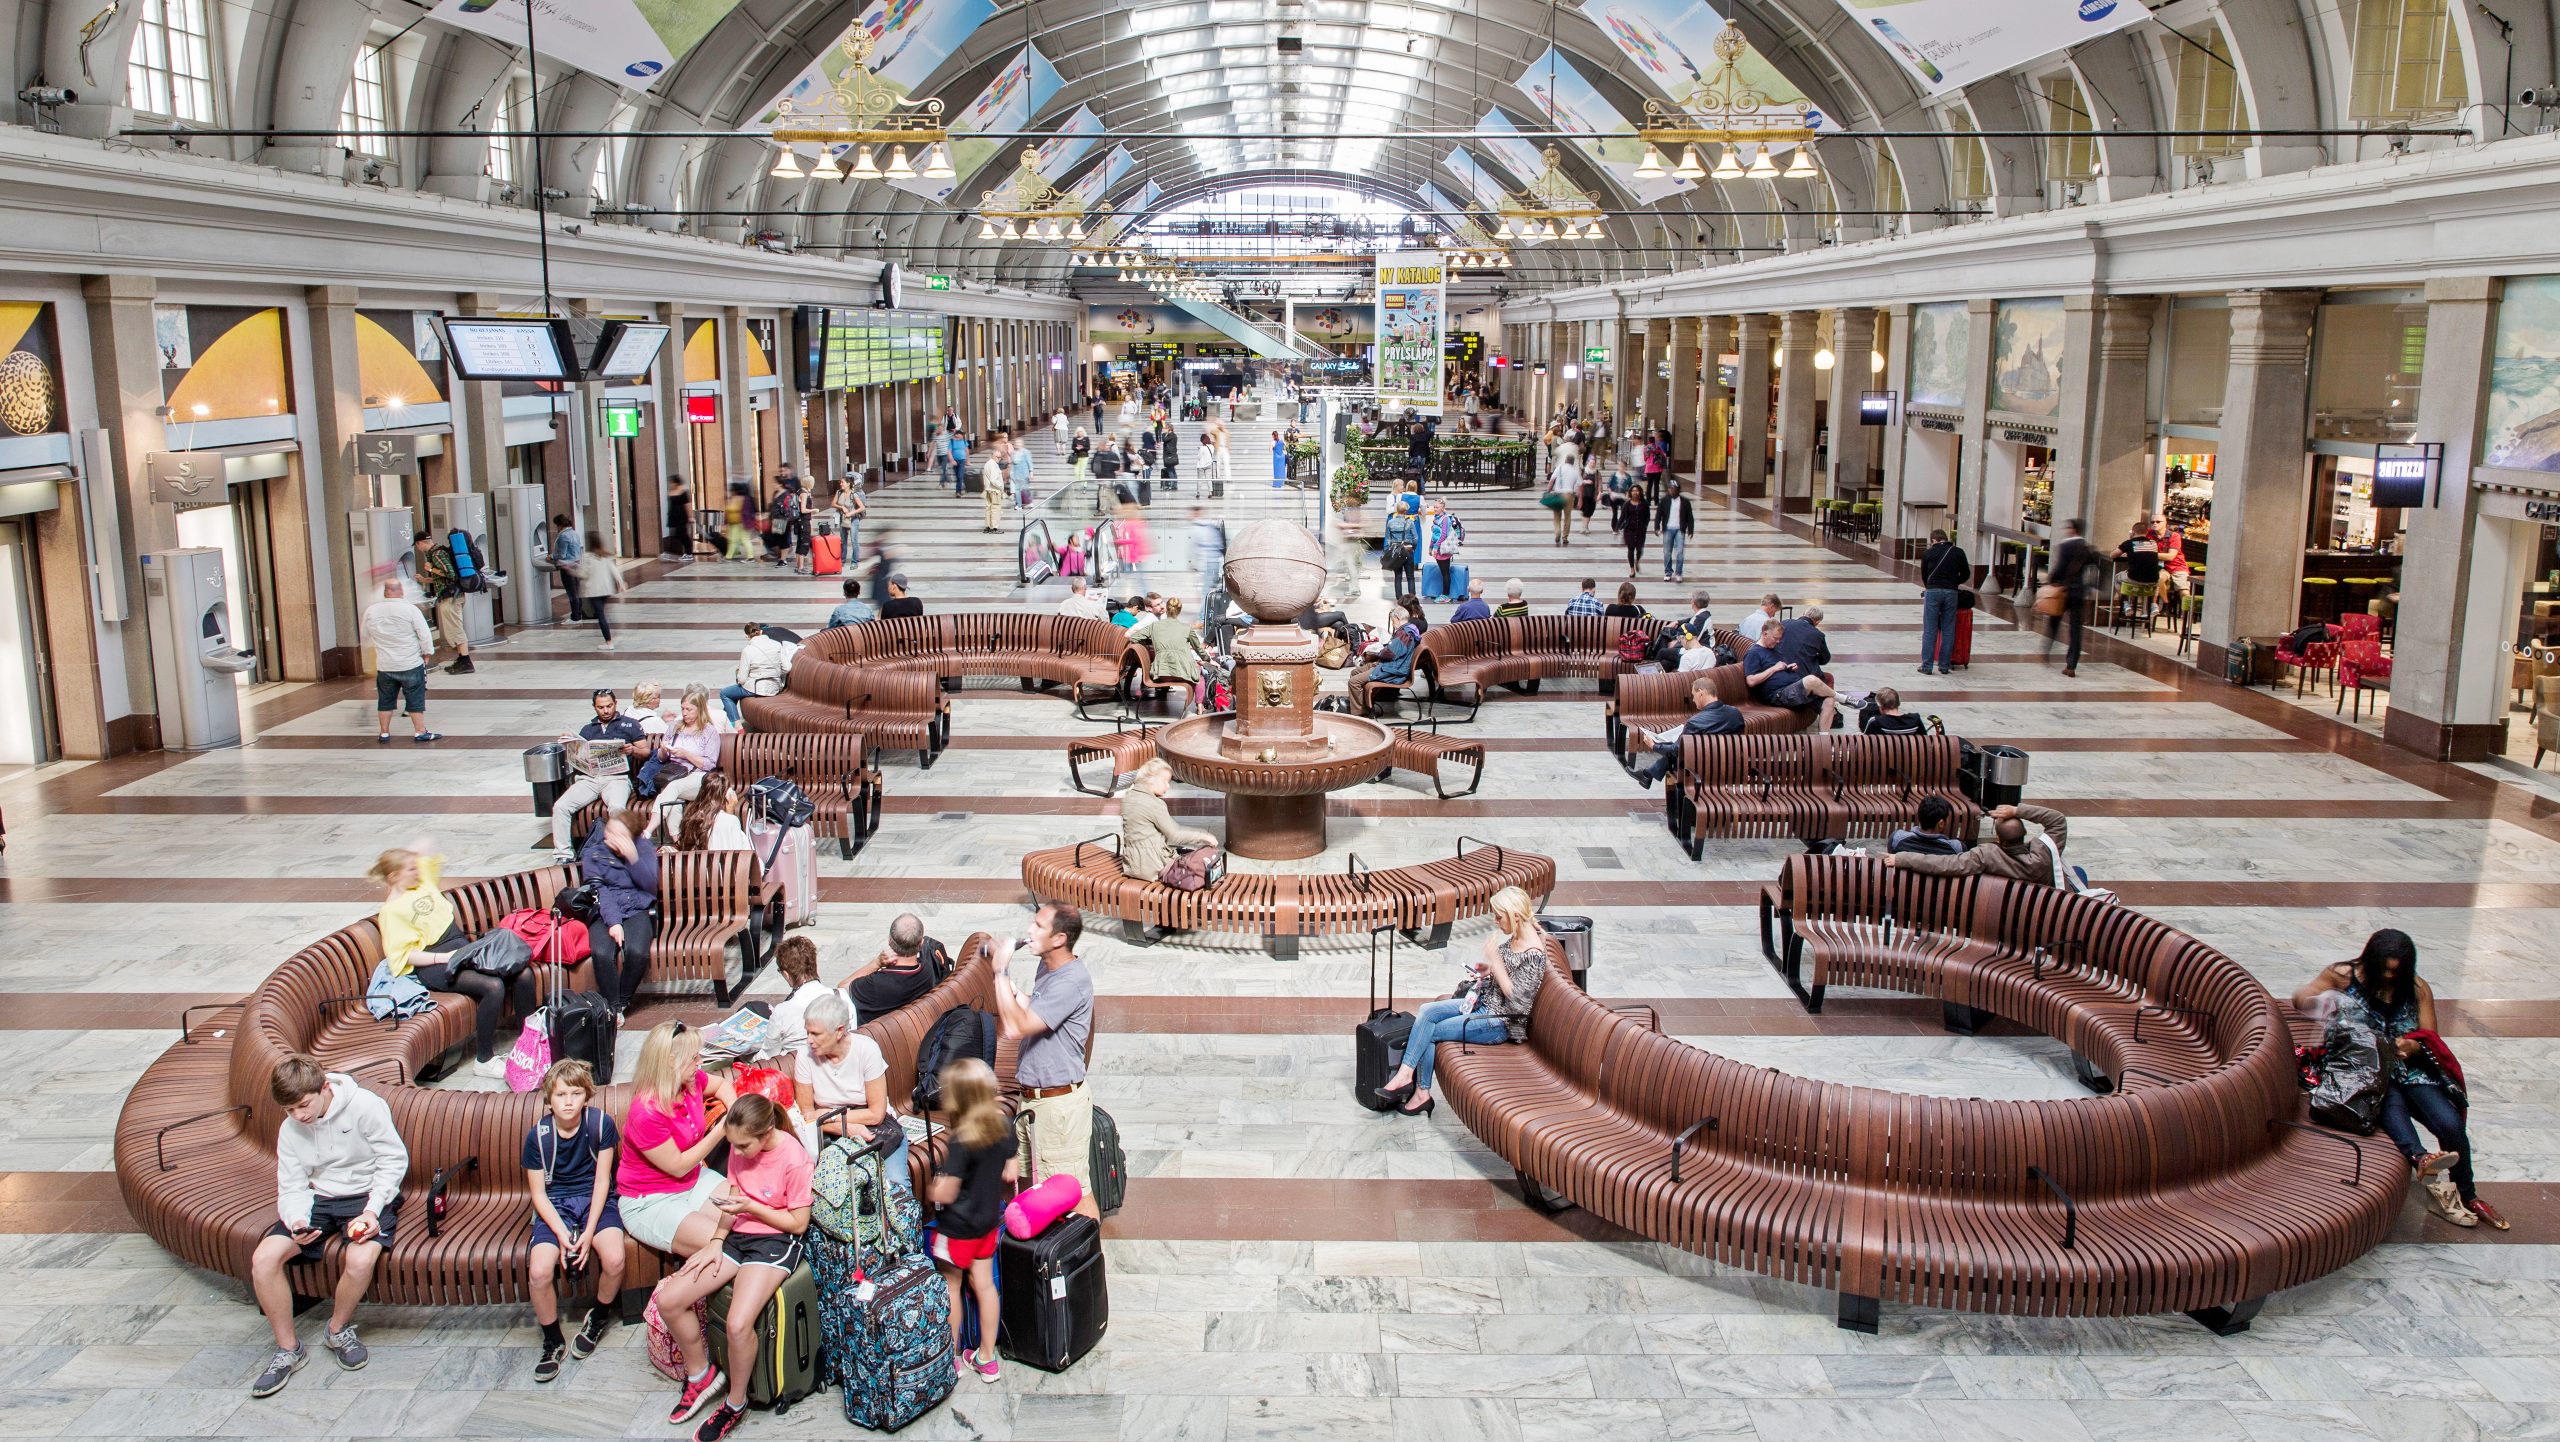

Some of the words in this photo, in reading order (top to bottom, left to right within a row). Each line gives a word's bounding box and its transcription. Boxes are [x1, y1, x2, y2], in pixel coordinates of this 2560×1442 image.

[2080, 0, 2116, 15] SAMSUN
[1380, 267, 1394, 284] NY
[1397, 266, 1441, 284] KATALOG
[1384, 344, 1436, 361] PRYLSLÄPP!
[1184, 362, 1220, 370] SAMSUNG
[1310, 362, 1337, 370] GALAXY
[378, 440, 394, 454] SJ
[178, 461, 198, 479] SJ
